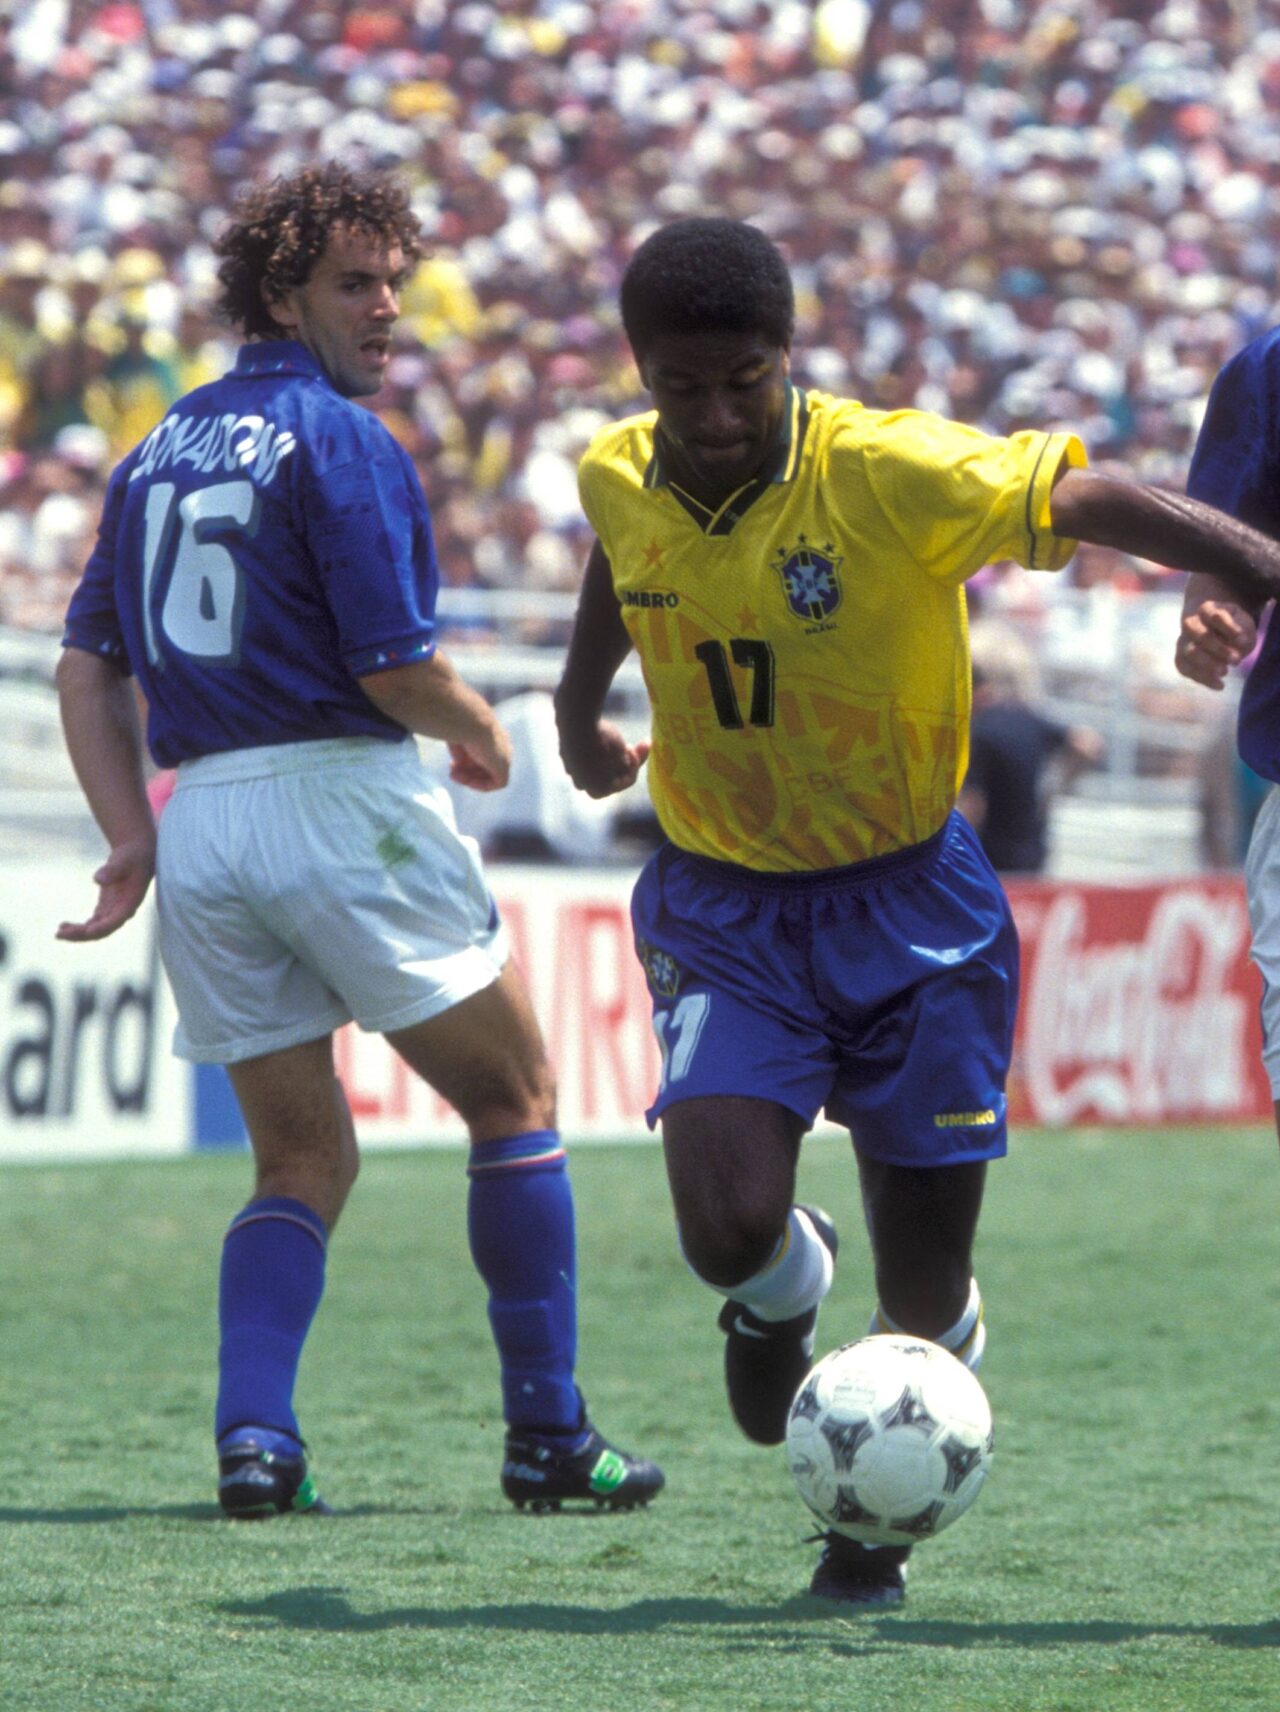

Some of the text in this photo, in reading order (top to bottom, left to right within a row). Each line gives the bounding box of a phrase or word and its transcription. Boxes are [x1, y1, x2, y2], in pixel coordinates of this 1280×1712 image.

[142, 480, 258, 668] 16
[694, 637, 776, 730] 17
[0, 920, 157, 1120] ard
